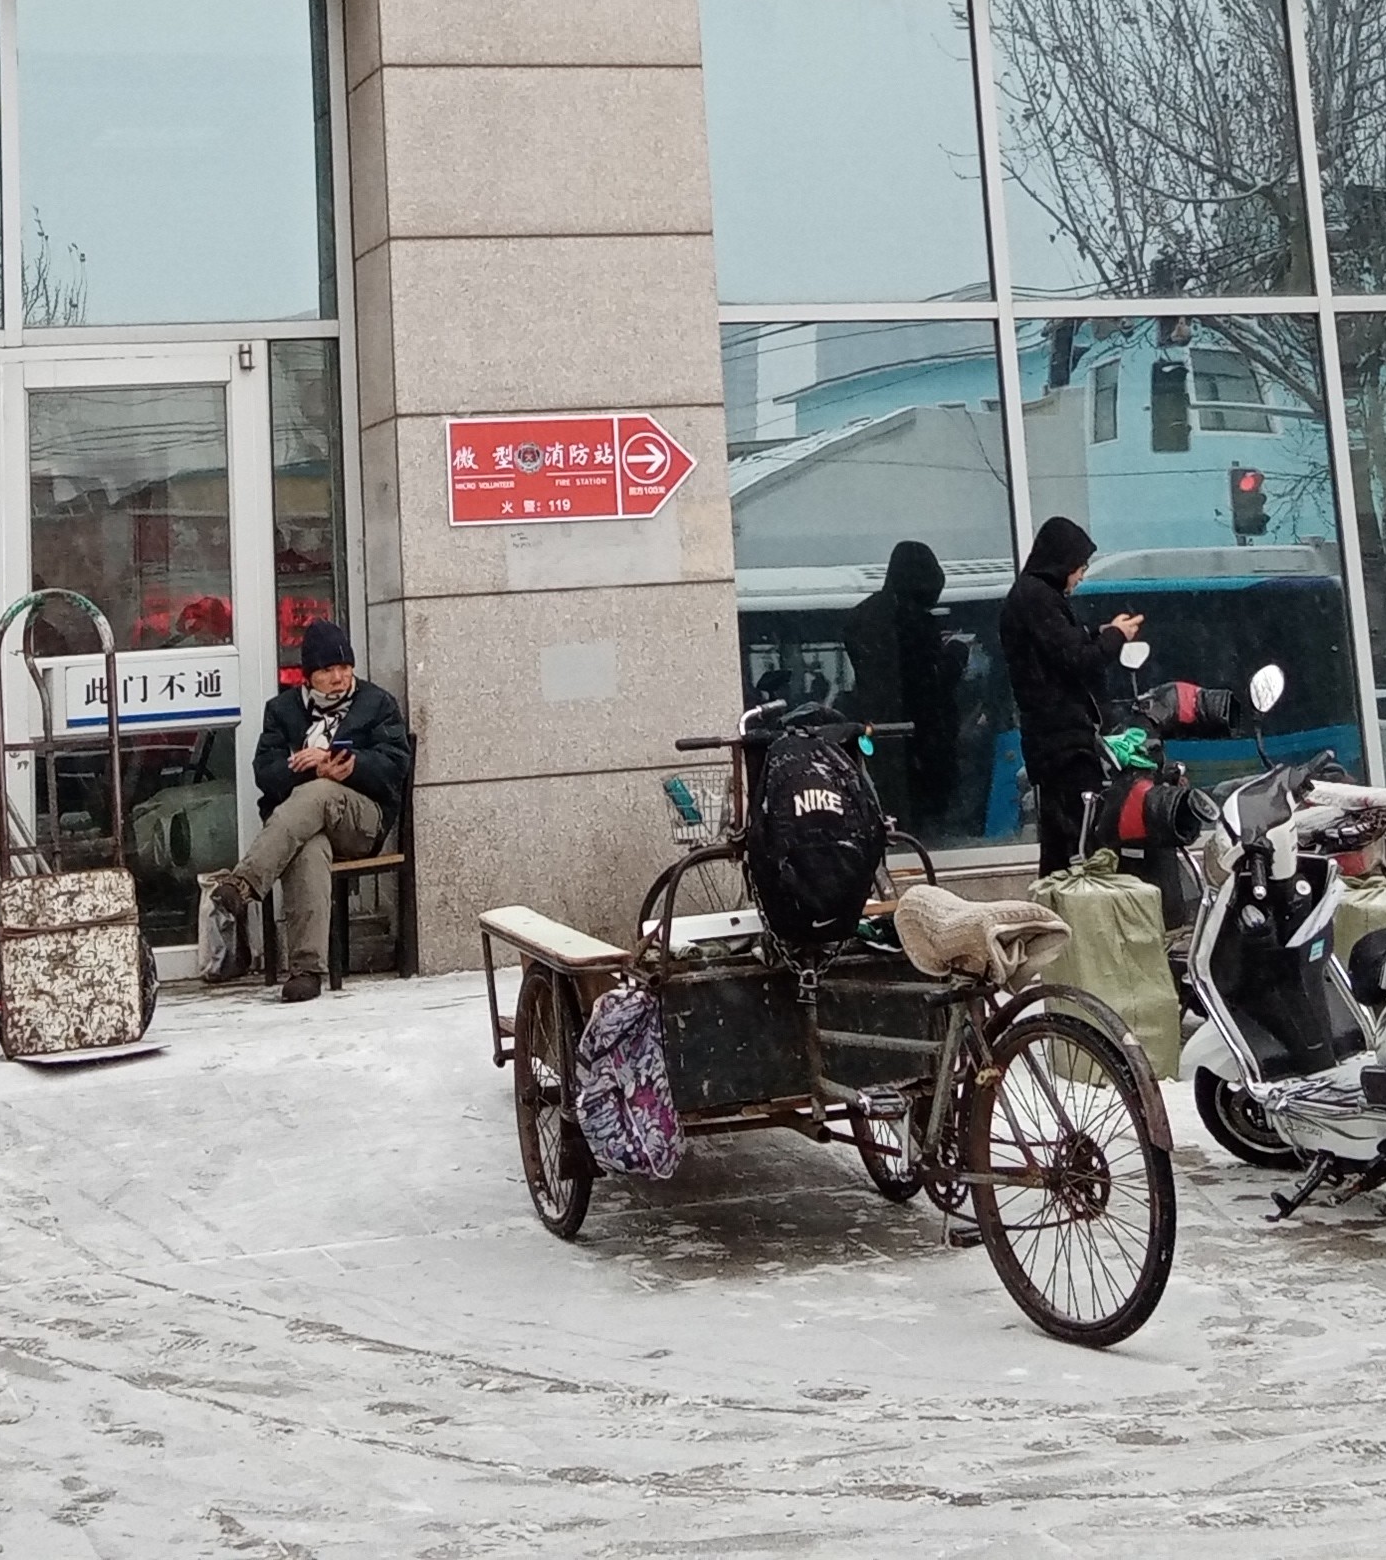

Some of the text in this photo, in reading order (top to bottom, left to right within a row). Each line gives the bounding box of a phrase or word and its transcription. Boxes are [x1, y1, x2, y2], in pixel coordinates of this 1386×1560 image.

[545, 441, 613, 468] 消防站
[575, 477, 607, 486] STATION
[85, 669, 222, 705] 此门不通
[793, 789, 844, 816] NIKE
